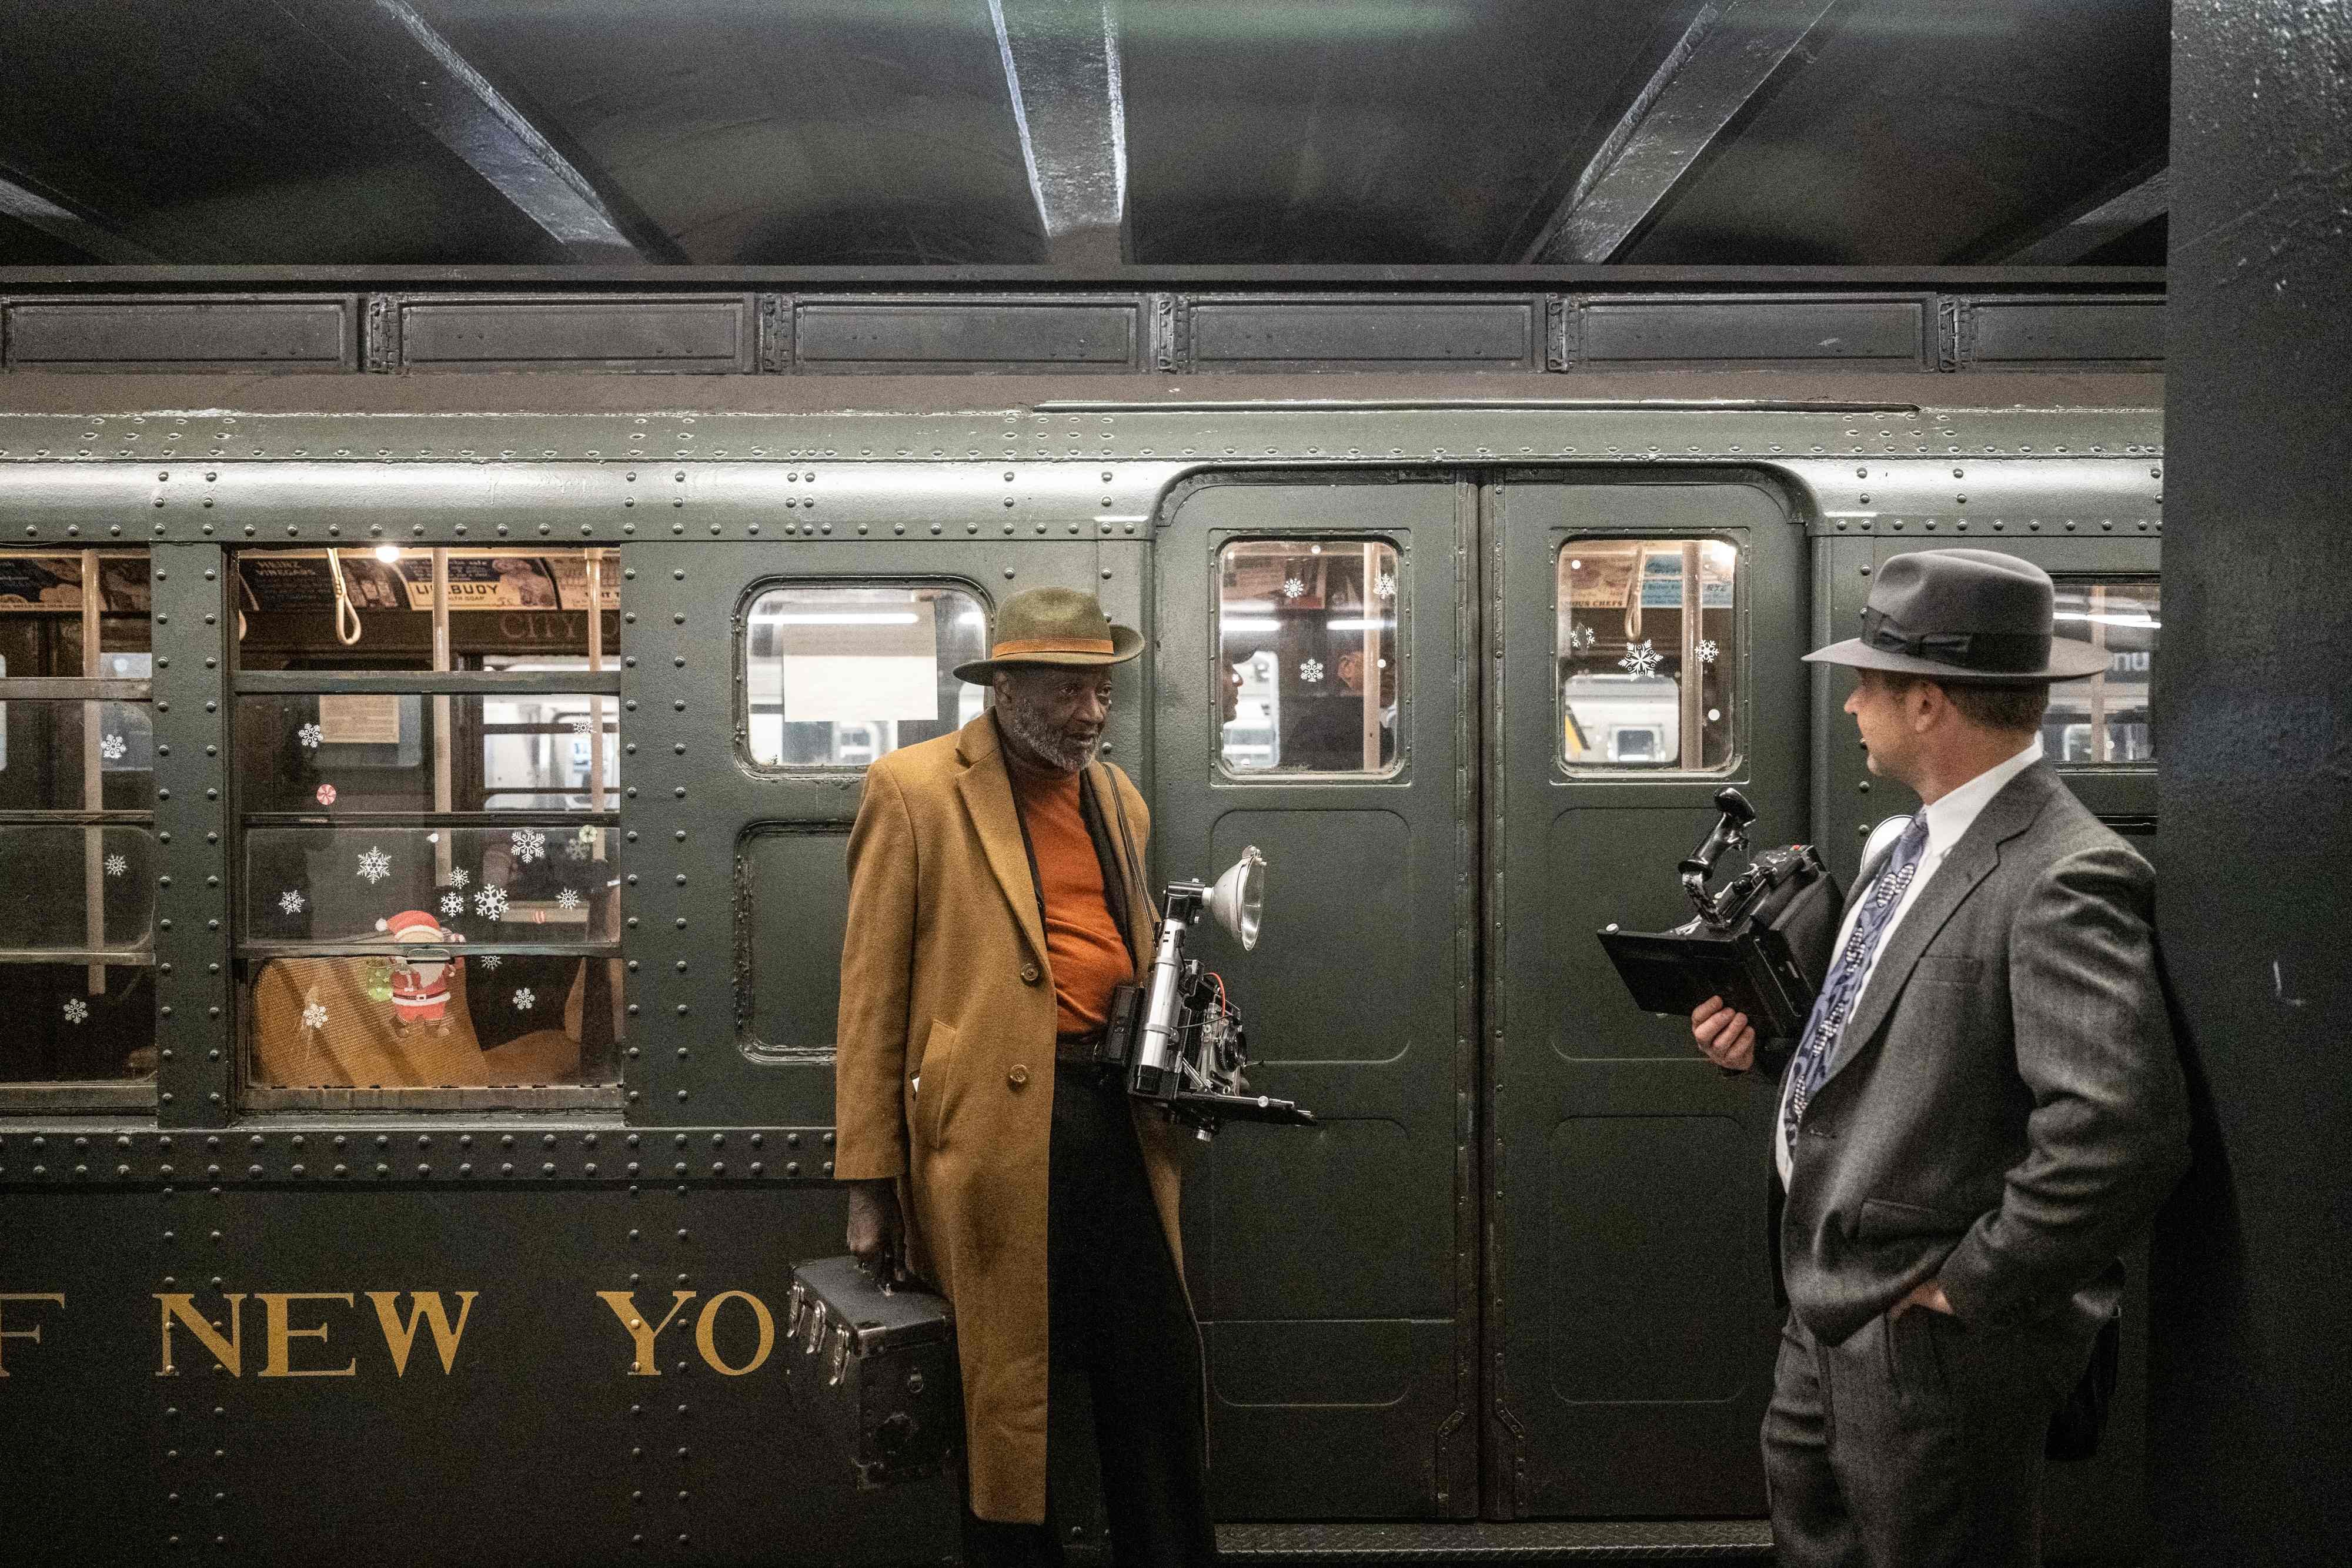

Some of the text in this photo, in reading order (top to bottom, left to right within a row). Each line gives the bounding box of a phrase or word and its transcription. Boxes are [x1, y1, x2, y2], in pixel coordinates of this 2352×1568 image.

[415, 584, 498, 595] LIBUOY
[499, 613, 582, 639] CITY
[152, 1291, 479, 1378] NEW
[596, 1290, 775, 1376] YO
